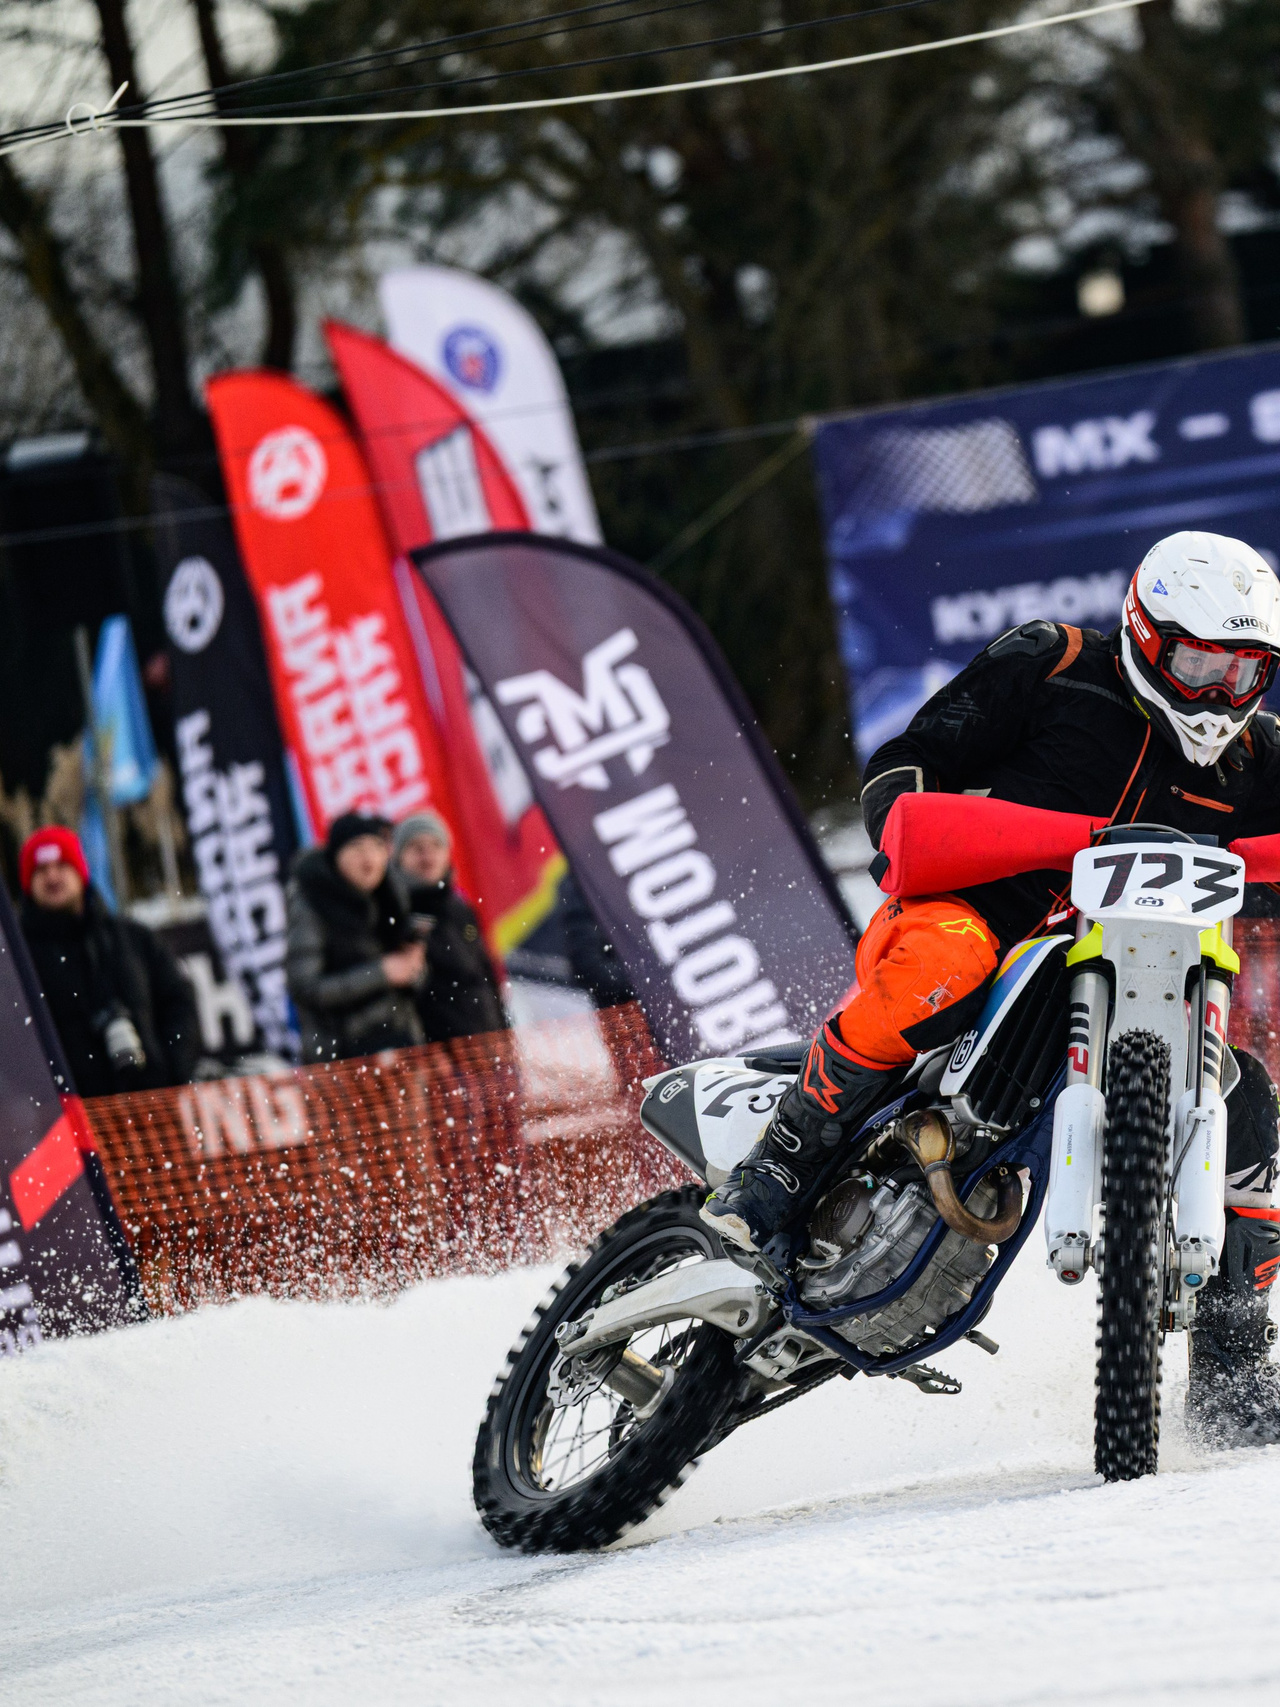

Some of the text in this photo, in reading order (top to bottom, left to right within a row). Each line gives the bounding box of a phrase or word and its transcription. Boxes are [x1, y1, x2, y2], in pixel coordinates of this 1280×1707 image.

[1032, 410, 1159, 477] MX
[929, 568, 1128, 645] КУБОК
[1229, 617, 1271, 634] SHOEI
[1094, 851, 1242, 914] 723
